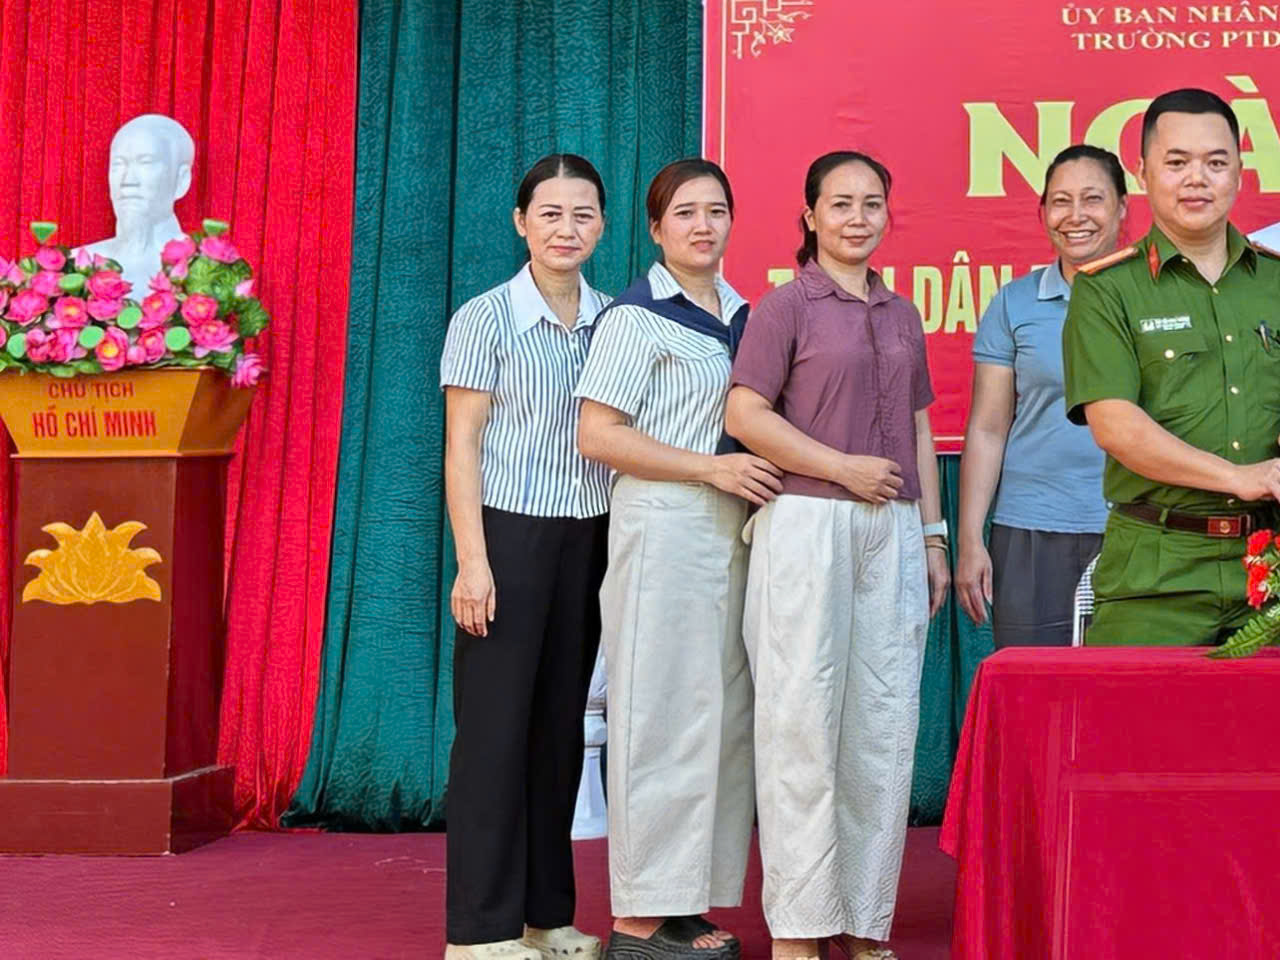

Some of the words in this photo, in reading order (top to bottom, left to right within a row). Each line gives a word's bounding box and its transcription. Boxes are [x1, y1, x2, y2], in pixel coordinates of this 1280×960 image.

[1114, 5, 1177, 24] BAN
[1187, 0, 1279, 23] NHÂN
[1071, 27, 1211, 50] TRƯỜNG
[103, 410, 157, 438] MINH
